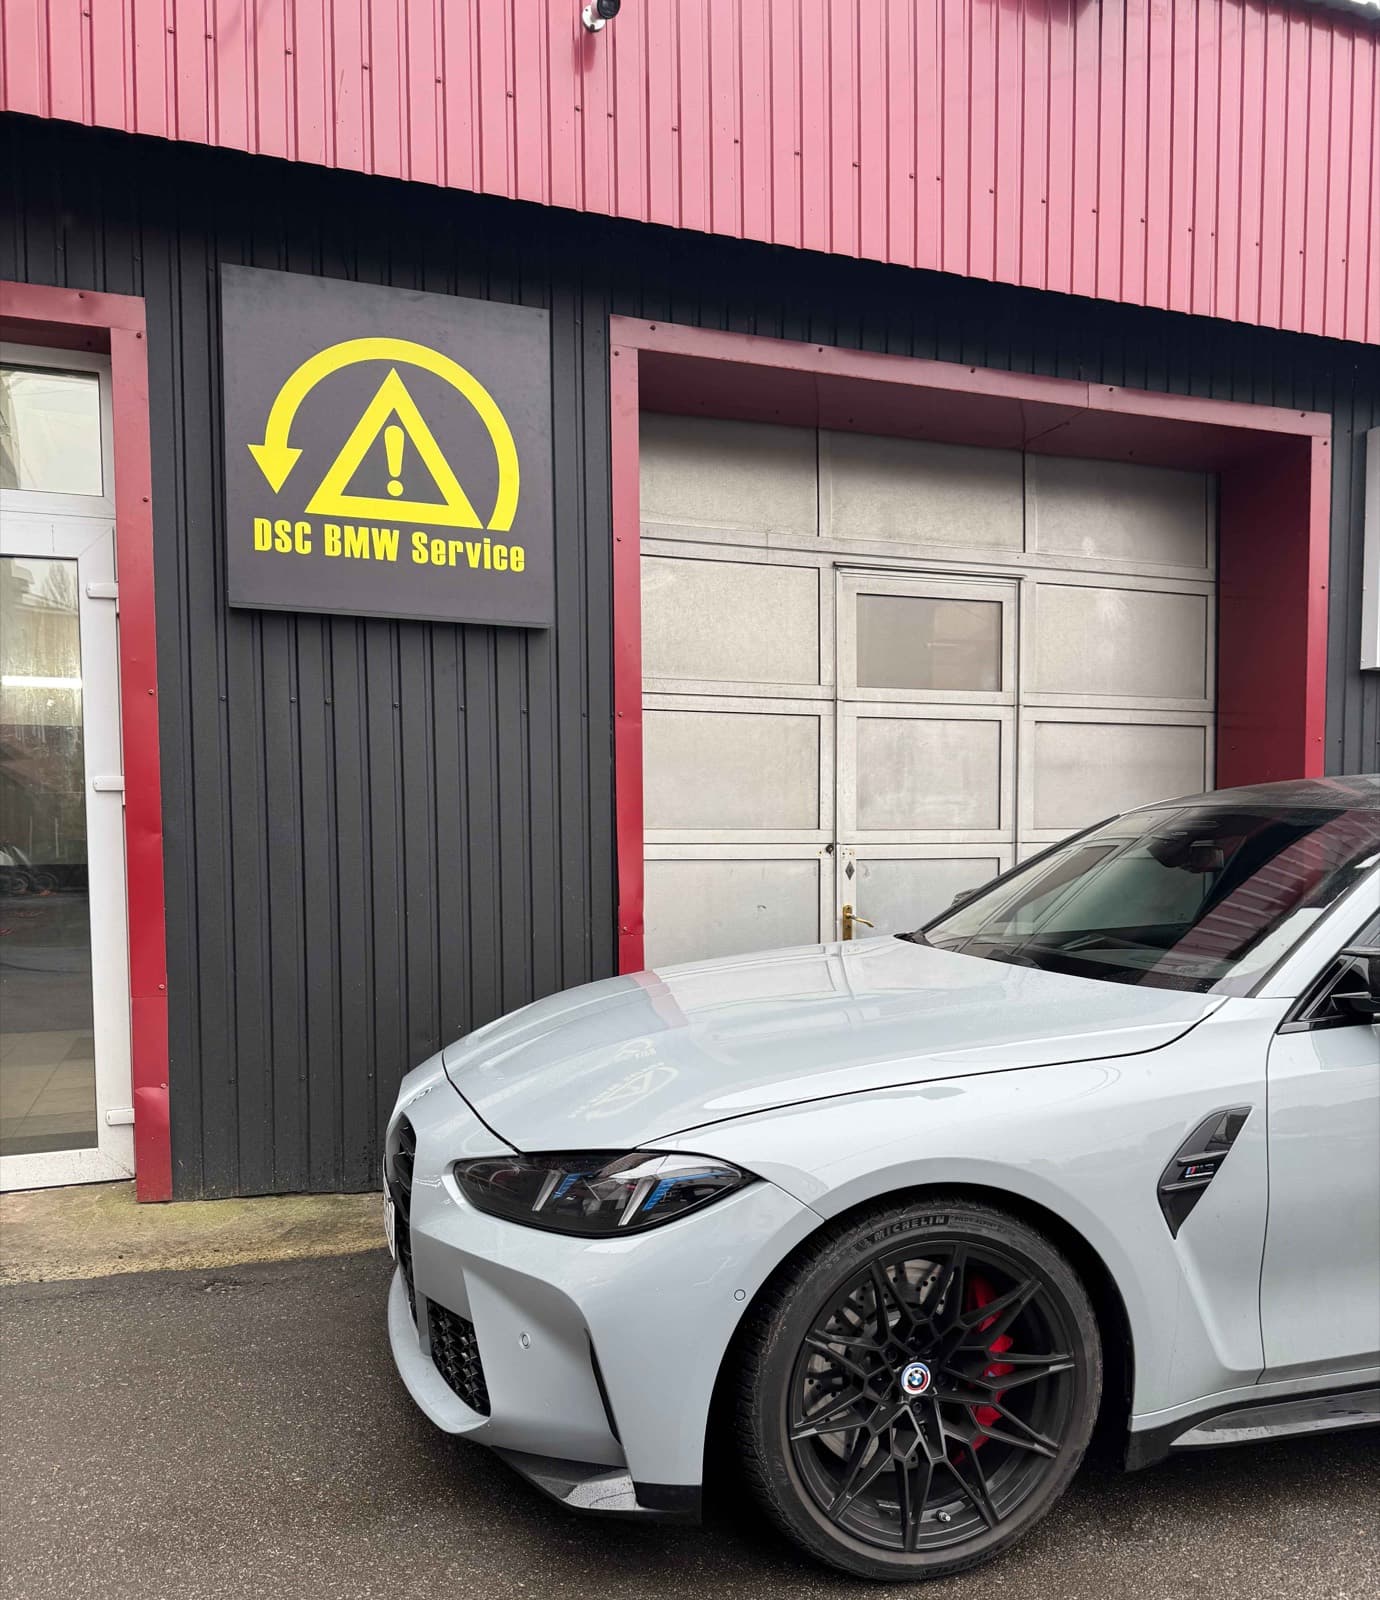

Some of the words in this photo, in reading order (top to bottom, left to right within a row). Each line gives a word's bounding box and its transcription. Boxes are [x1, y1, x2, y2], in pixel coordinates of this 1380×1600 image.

[253, 517, 313, 555] DSC
[323, 523, 400, 562] BMW
[411, 531, 525, 573] Service
[873, 1215, 946, 1242] MICHELIN
